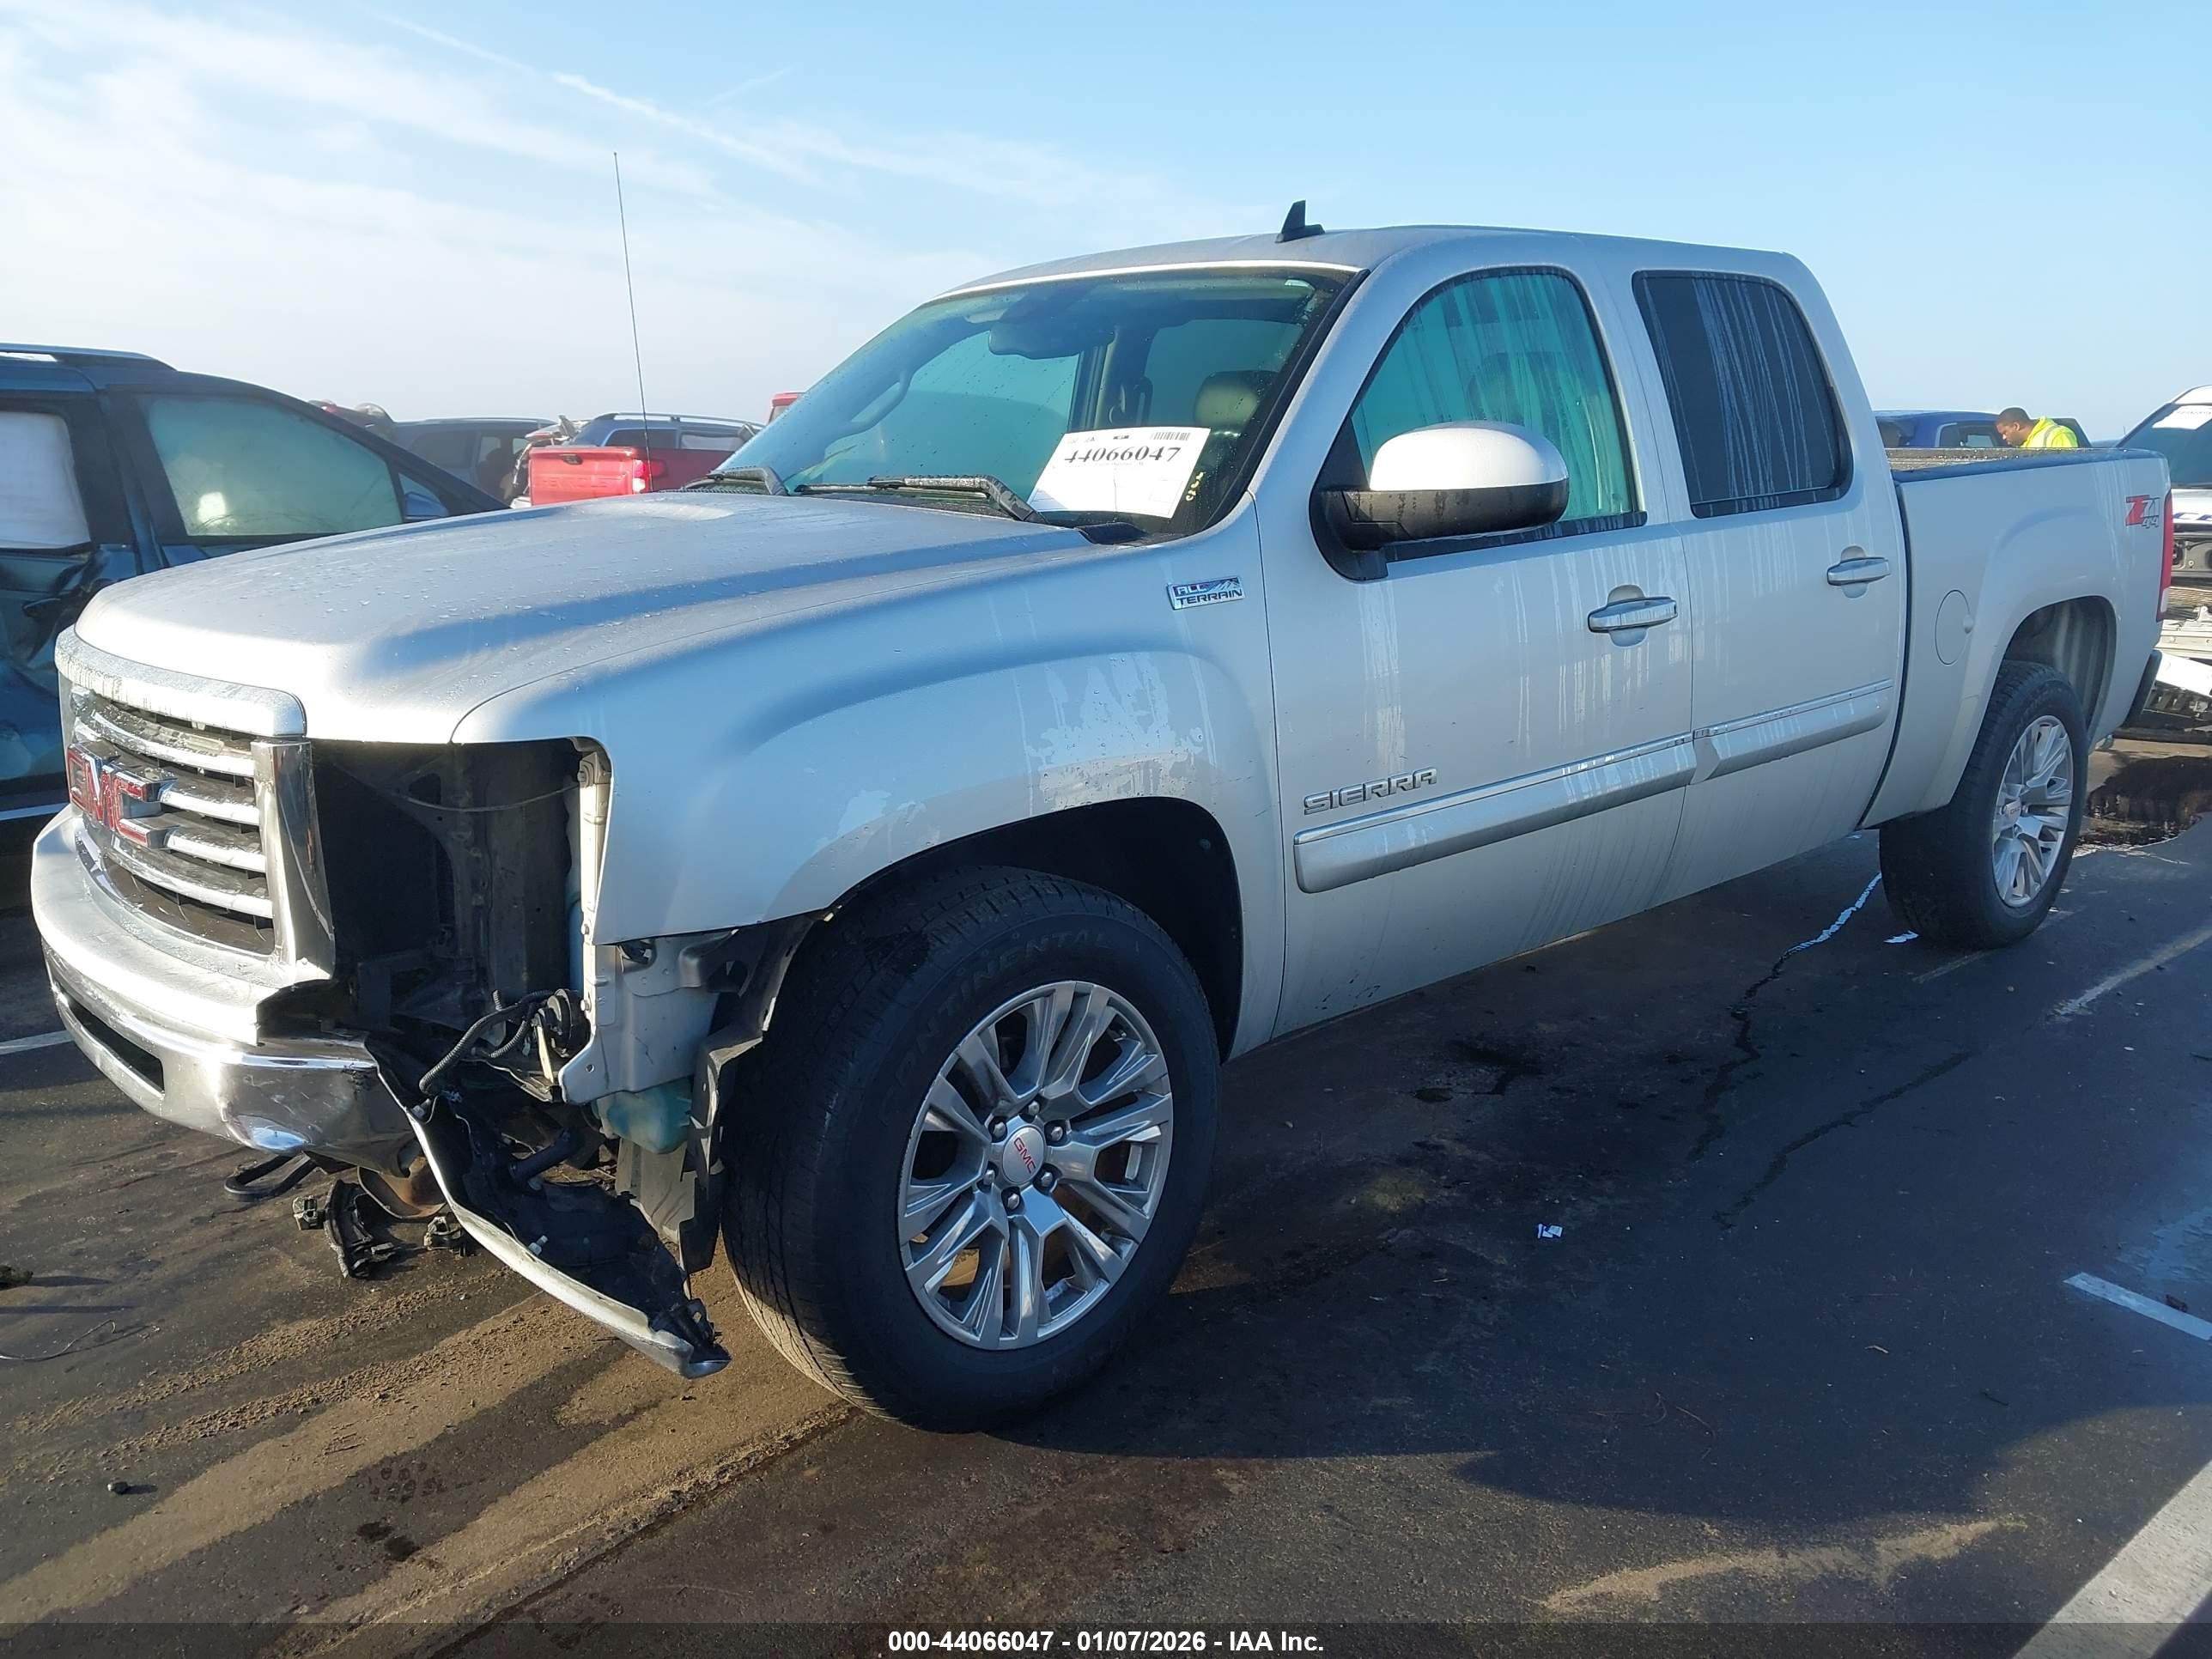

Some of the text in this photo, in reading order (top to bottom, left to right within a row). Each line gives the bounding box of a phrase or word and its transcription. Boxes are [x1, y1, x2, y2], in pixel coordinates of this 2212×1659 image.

[1064, 446, 1182, 463] 44066047
[2124, 494, 2161, 526] Z71
[1176, 584, 1207, 595] ALL
[1176, 589, 1243, 605] TERRAIN
[1304, 766, 1437, 816] SIERRA
[1013, 1136, 1036, 1174] GMC
